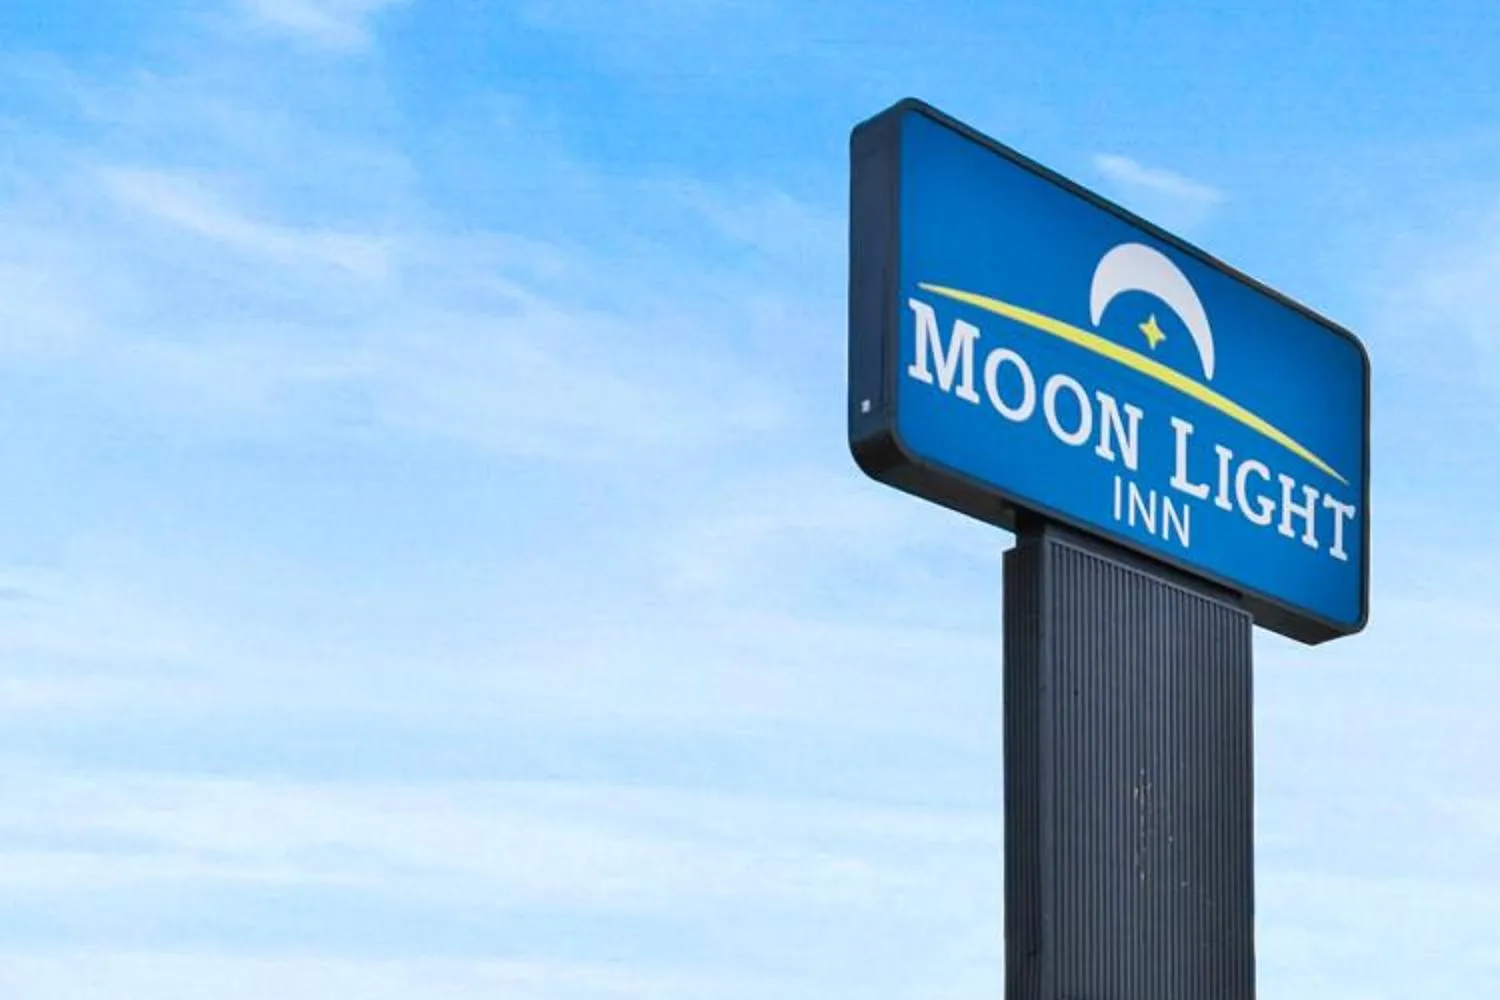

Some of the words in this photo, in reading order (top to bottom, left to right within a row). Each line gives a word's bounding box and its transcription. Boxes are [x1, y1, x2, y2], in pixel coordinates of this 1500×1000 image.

[908, 298, 1144, 471] MOON
[1170, 416, 1356, 561] LIGHT
[1113, 476, 1191, 549] INN
